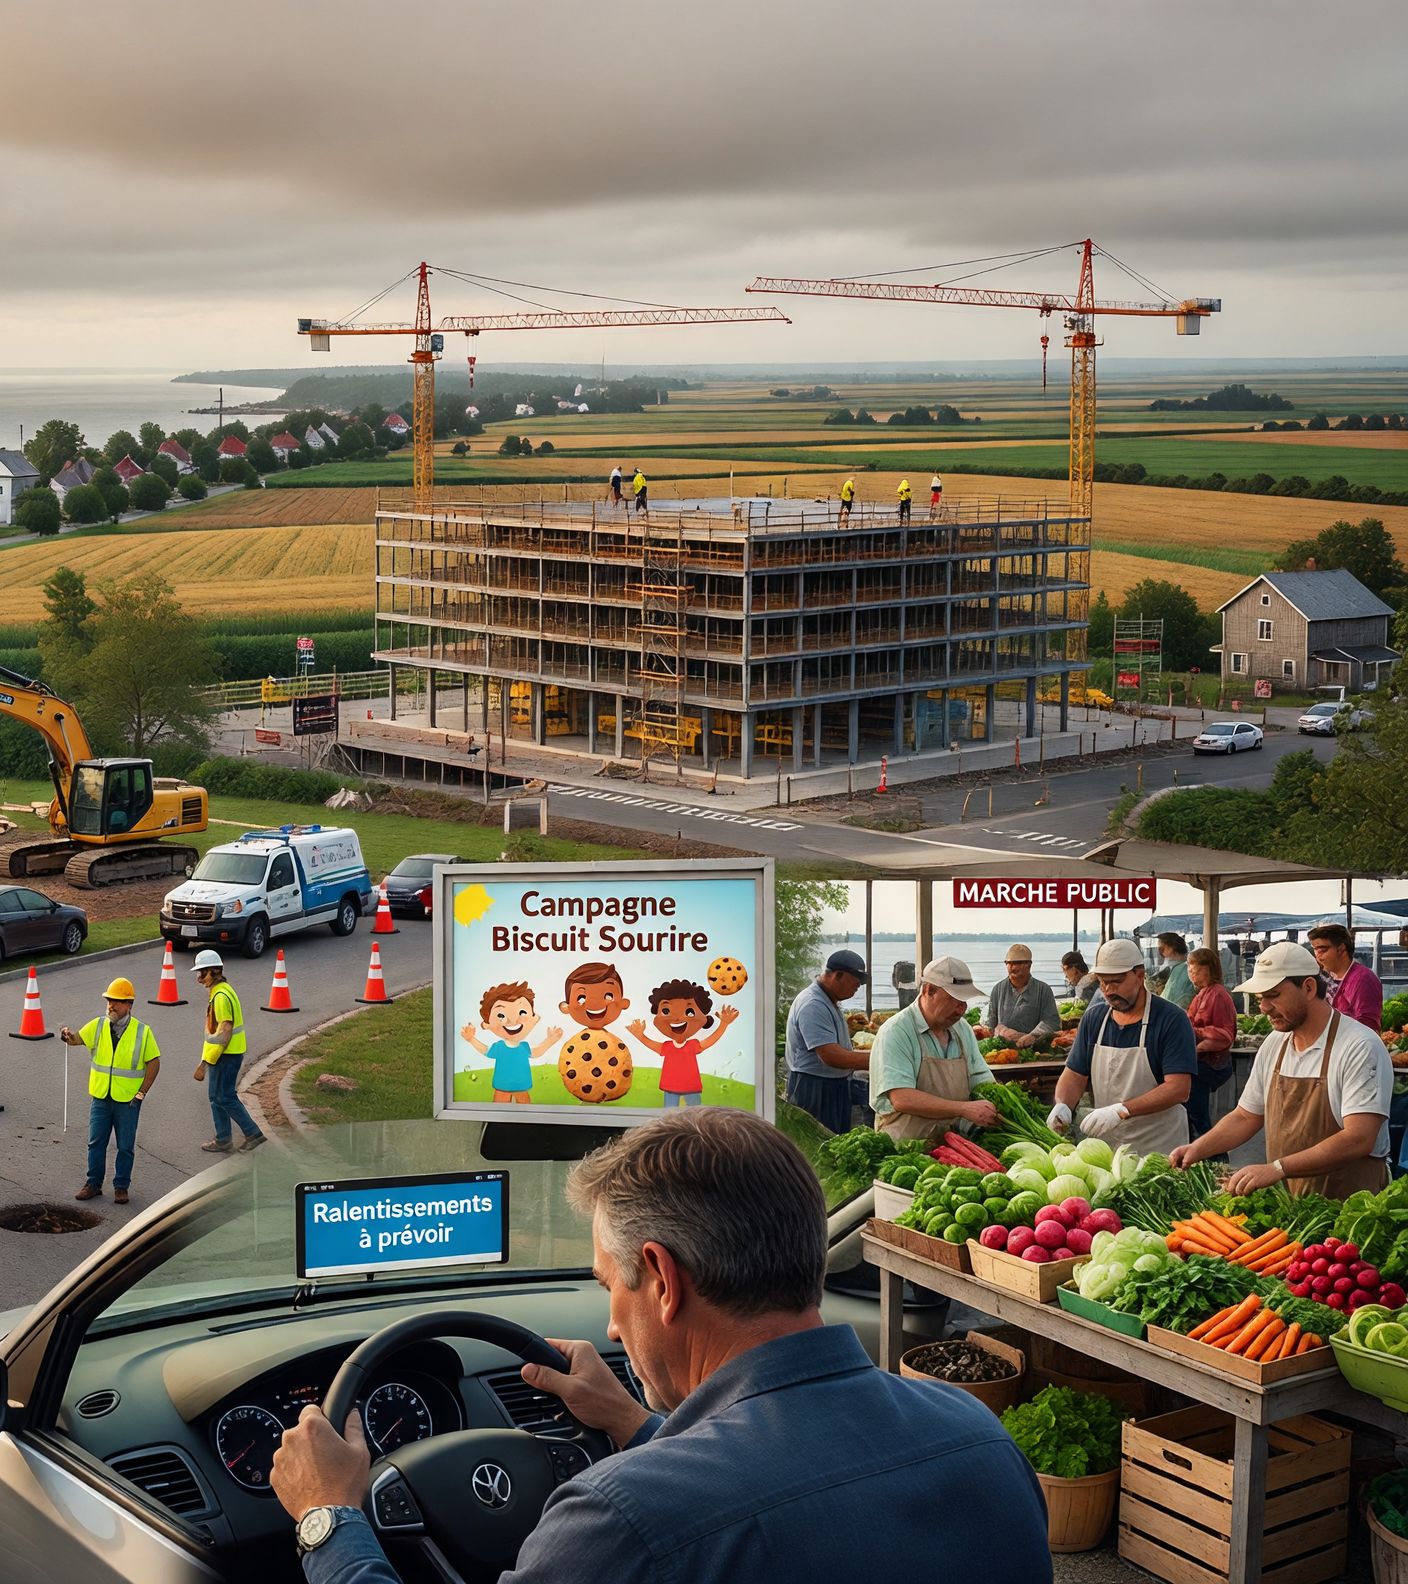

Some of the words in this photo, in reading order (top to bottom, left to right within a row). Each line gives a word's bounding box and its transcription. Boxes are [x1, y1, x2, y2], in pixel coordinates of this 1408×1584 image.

[959, 882, 1058, 903] MARCHE
[1067, 883, 1150, 903] PUBLIC
[520, 890, 676, 925] Campagne
[492, 926, 590, 952] Biscuit
[598, 925, 708, 953] Sourire
[313, 1194, 493, 1223] Ralentissements
[358, 1228, 372, 1249] à
[378, 1222, 454, 1252] prévoir
